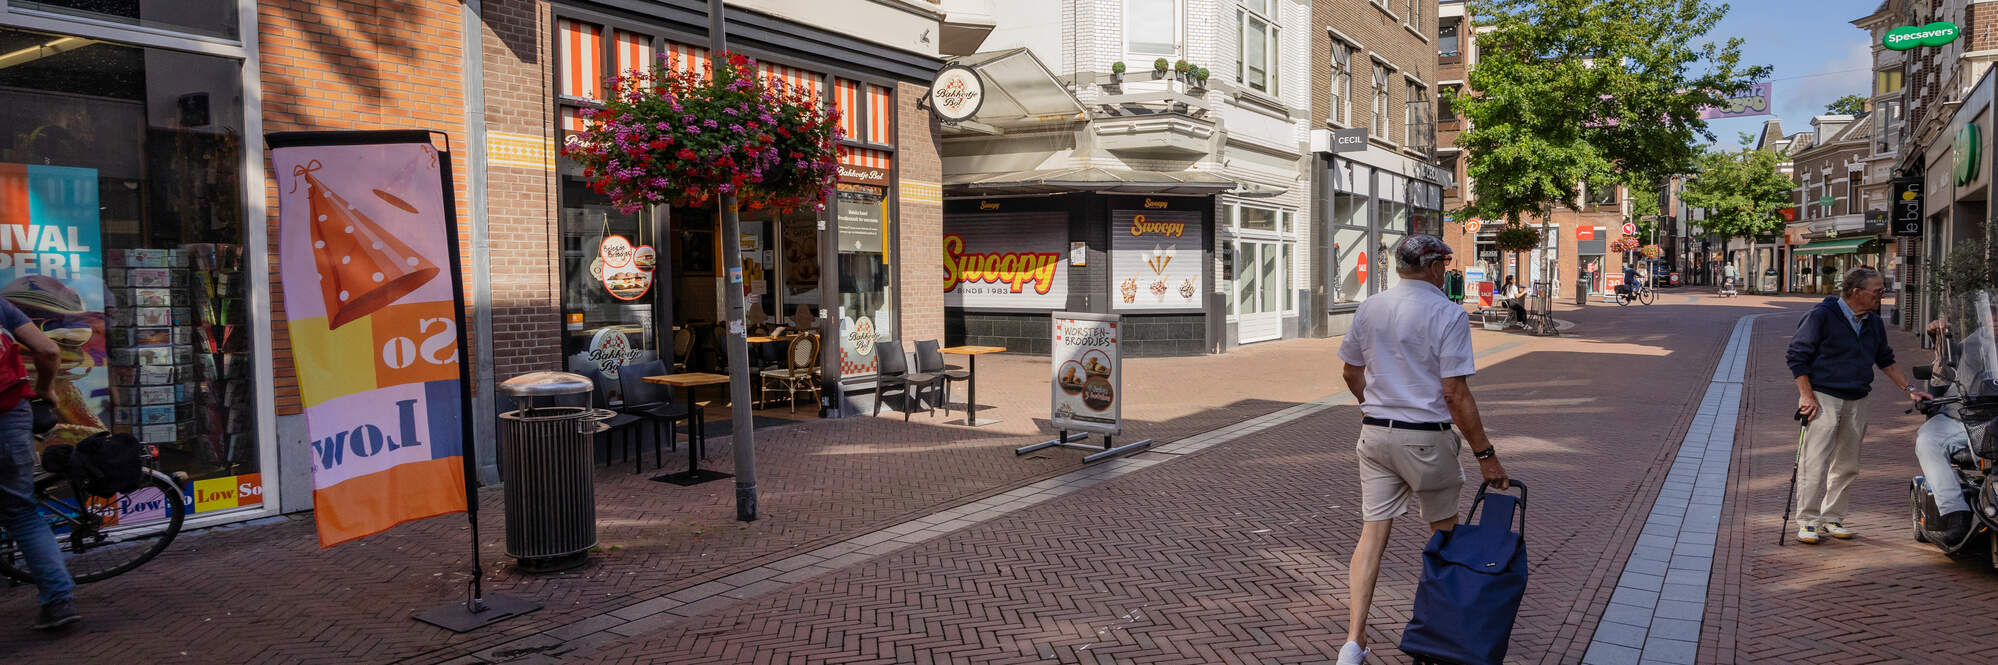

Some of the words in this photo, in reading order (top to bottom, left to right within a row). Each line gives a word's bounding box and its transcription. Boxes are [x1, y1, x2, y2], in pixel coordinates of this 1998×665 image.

[1888, 27, 1954, 44] Specsavers
[1338, 136, 1363, 144] CECIL
[1129, 214, 1185, 237] Swoopy
[943, 232, 1060, 295] Swoopy
[986, 287, 1009, 295] 1983
[1064, 327, 1111, 337] WORSTEN-
[1064, 336, 1111, 347] BROODJES
[121, 500, 161, 515] Low
[198, 490, 234, 504] Low
[240, 483, 263, 498] So
